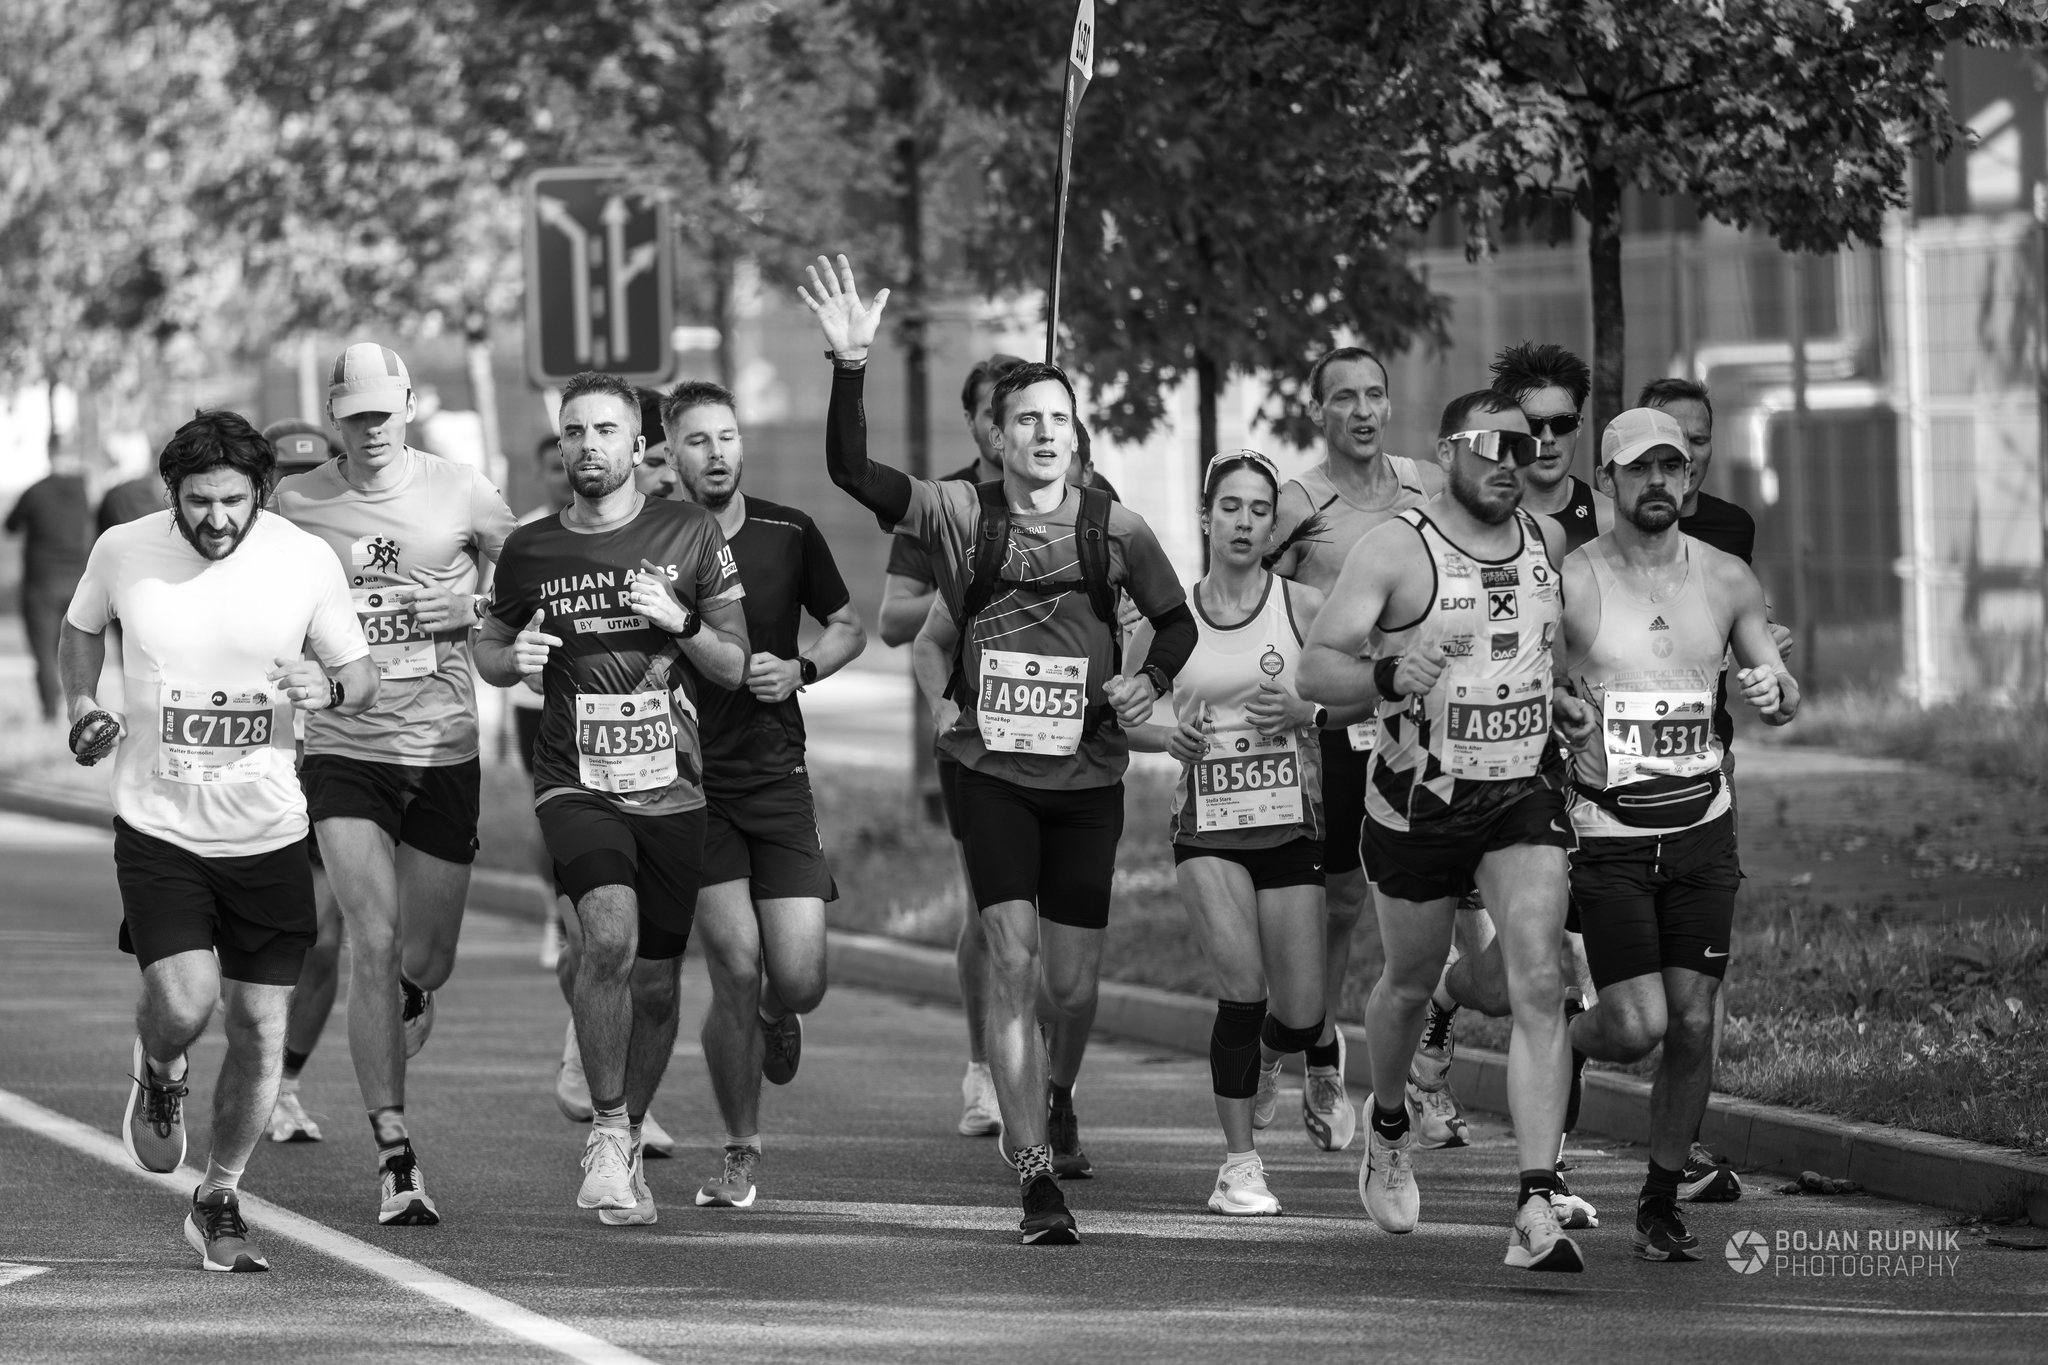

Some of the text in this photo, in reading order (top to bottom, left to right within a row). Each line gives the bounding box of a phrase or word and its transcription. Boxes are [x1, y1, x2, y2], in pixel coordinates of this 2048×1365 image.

[539, 571, 615, 600] JULIAN
[549, 593, 611, 617] TRAIL
[1441, 597, 1477, 611] EJOT
[580, 617, 642, 631] BY UTMB
[994, 682, 1078, 717] A9055
[182, 714, 268, 745] C7128
[1464, 703, 1543, 740] A8593
[594, 720, 671, 755] A3538
[1212, 758, 1294, 792] B5656
